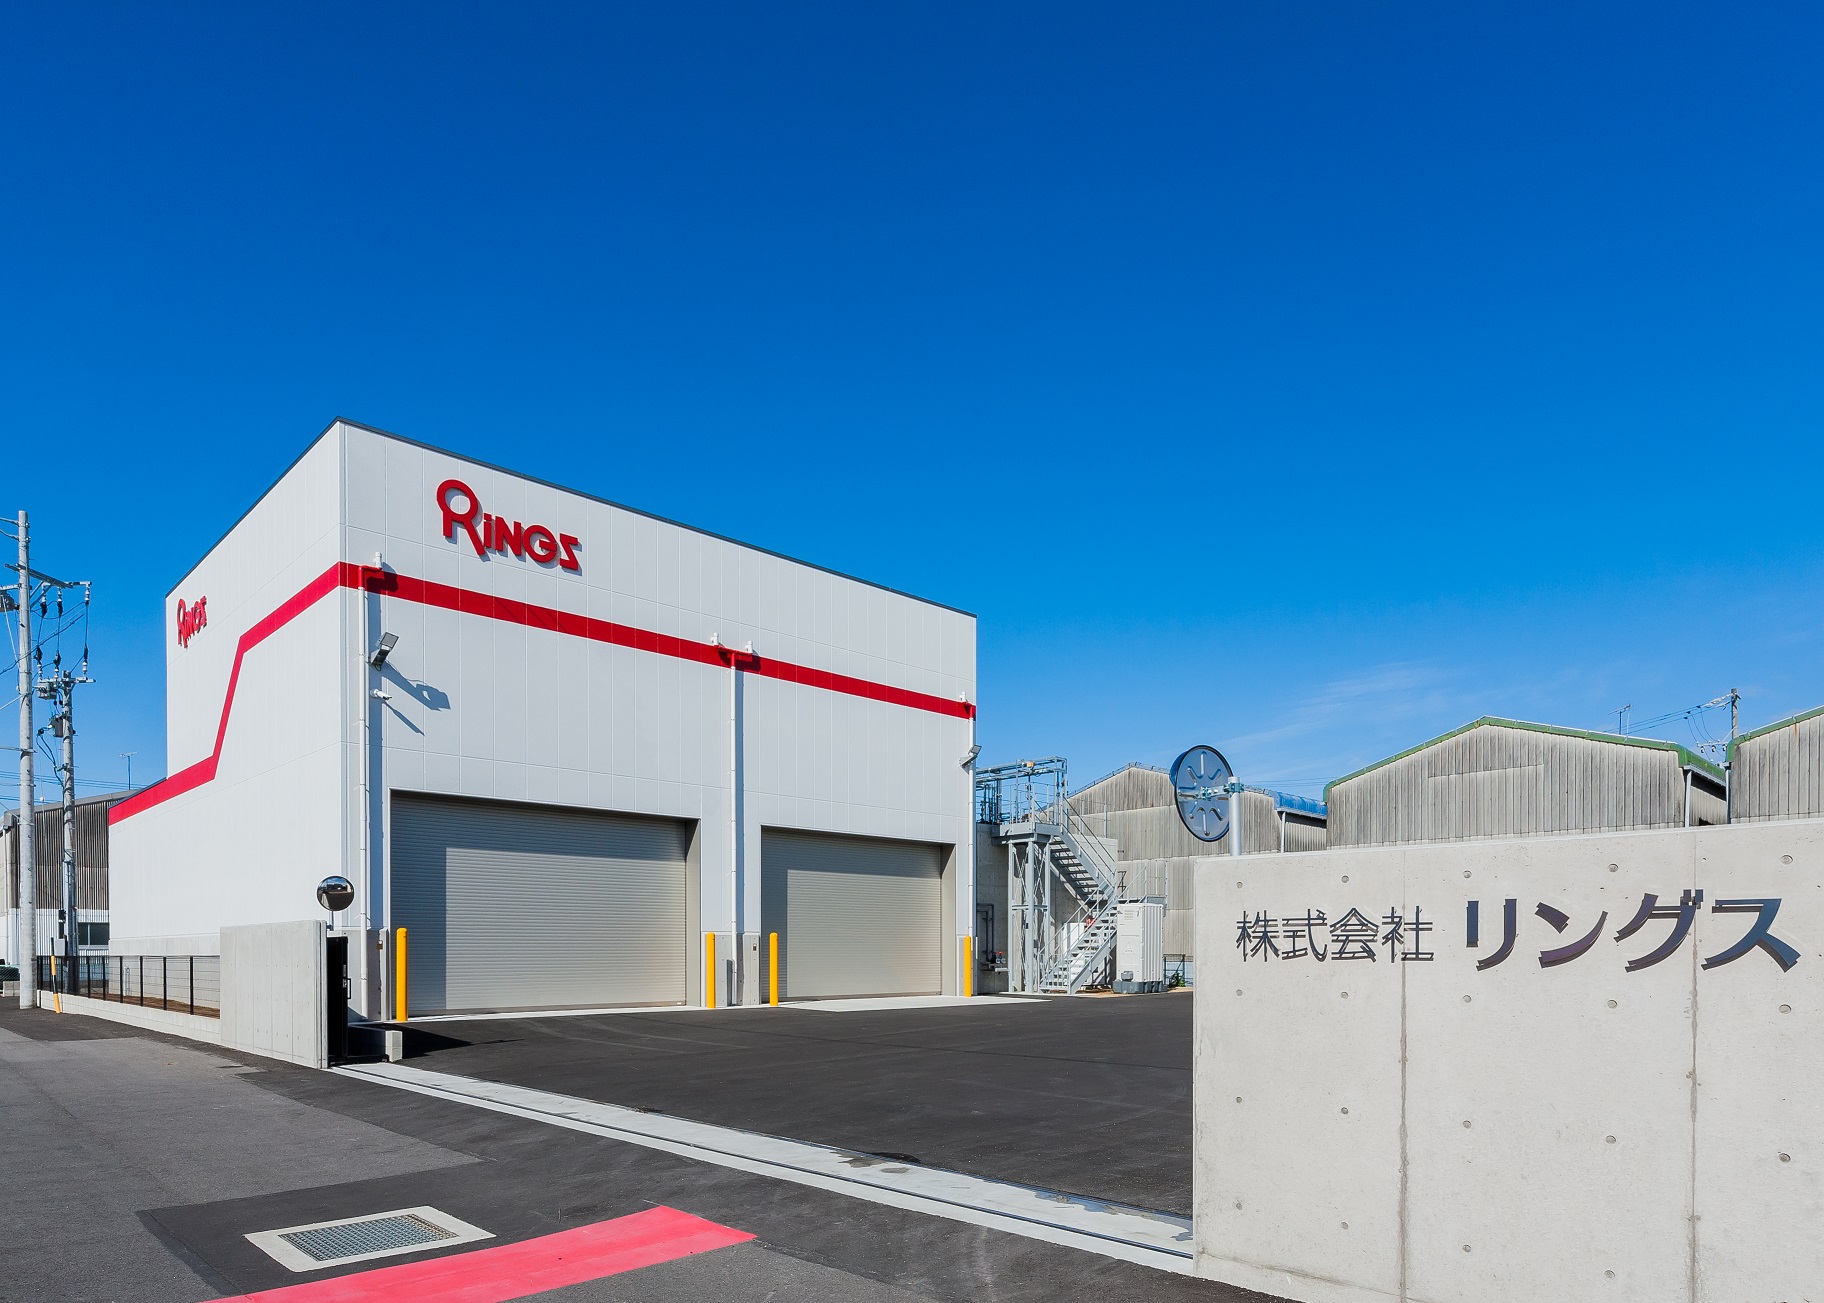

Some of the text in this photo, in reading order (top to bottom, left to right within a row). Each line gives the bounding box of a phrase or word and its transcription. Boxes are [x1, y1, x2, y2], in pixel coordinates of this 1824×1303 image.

[1236, 889, 1802, 973] 株式会社 リングス
